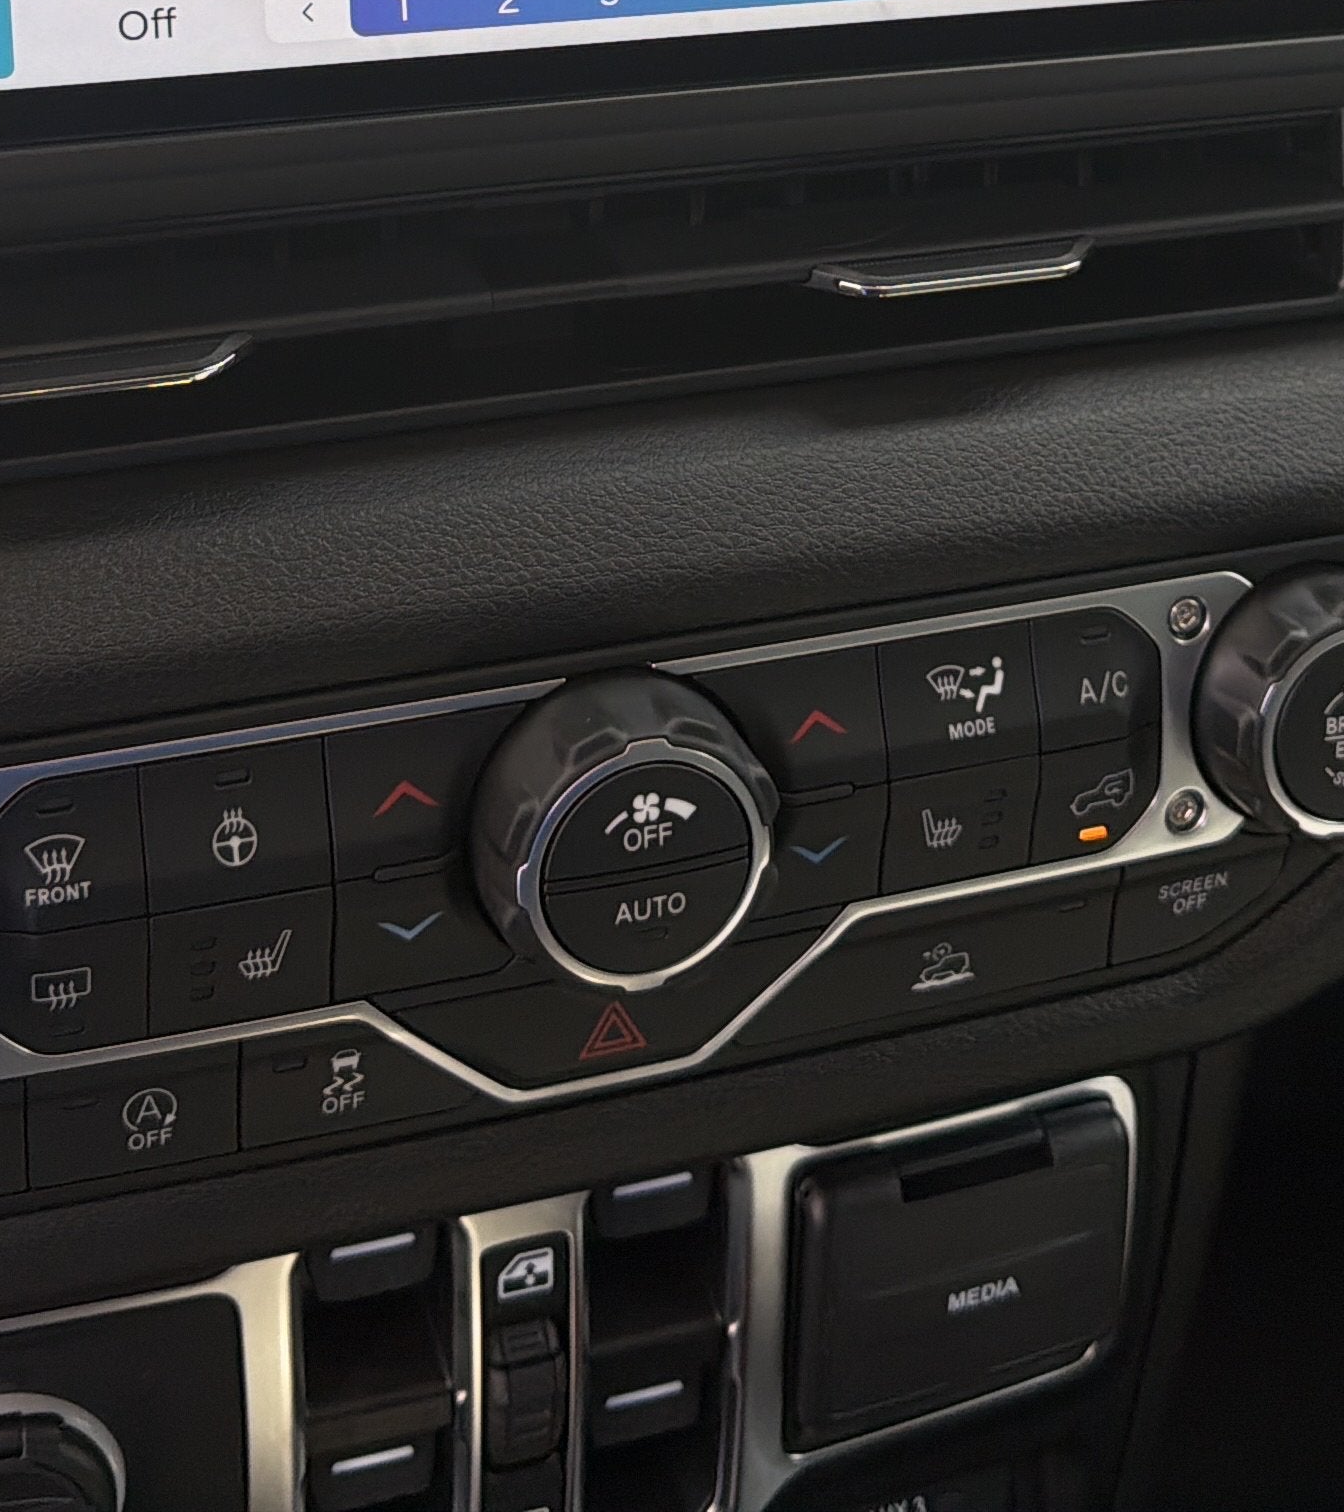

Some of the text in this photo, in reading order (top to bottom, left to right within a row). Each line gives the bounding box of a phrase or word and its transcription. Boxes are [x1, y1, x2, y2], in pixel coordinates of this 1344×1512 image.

[117, 6, 177, 42] Off
[1078, 670, 1130, 704] A/C
[947, 716, 997, 741] MODE
[622, 821, 674, 854] OFF
[23, 880, 93, 908] FRONT
[1157, 870, 1229, 901] SCREEN
[613, 892, 688, 926] AUTO
[1172, 890, 1209, 916] OFF
[320, 1090, 367, 1115] OFF
[127, 1126, 174, 1152] OFF
[946, 1275, 1022, 1313] MEDIA
